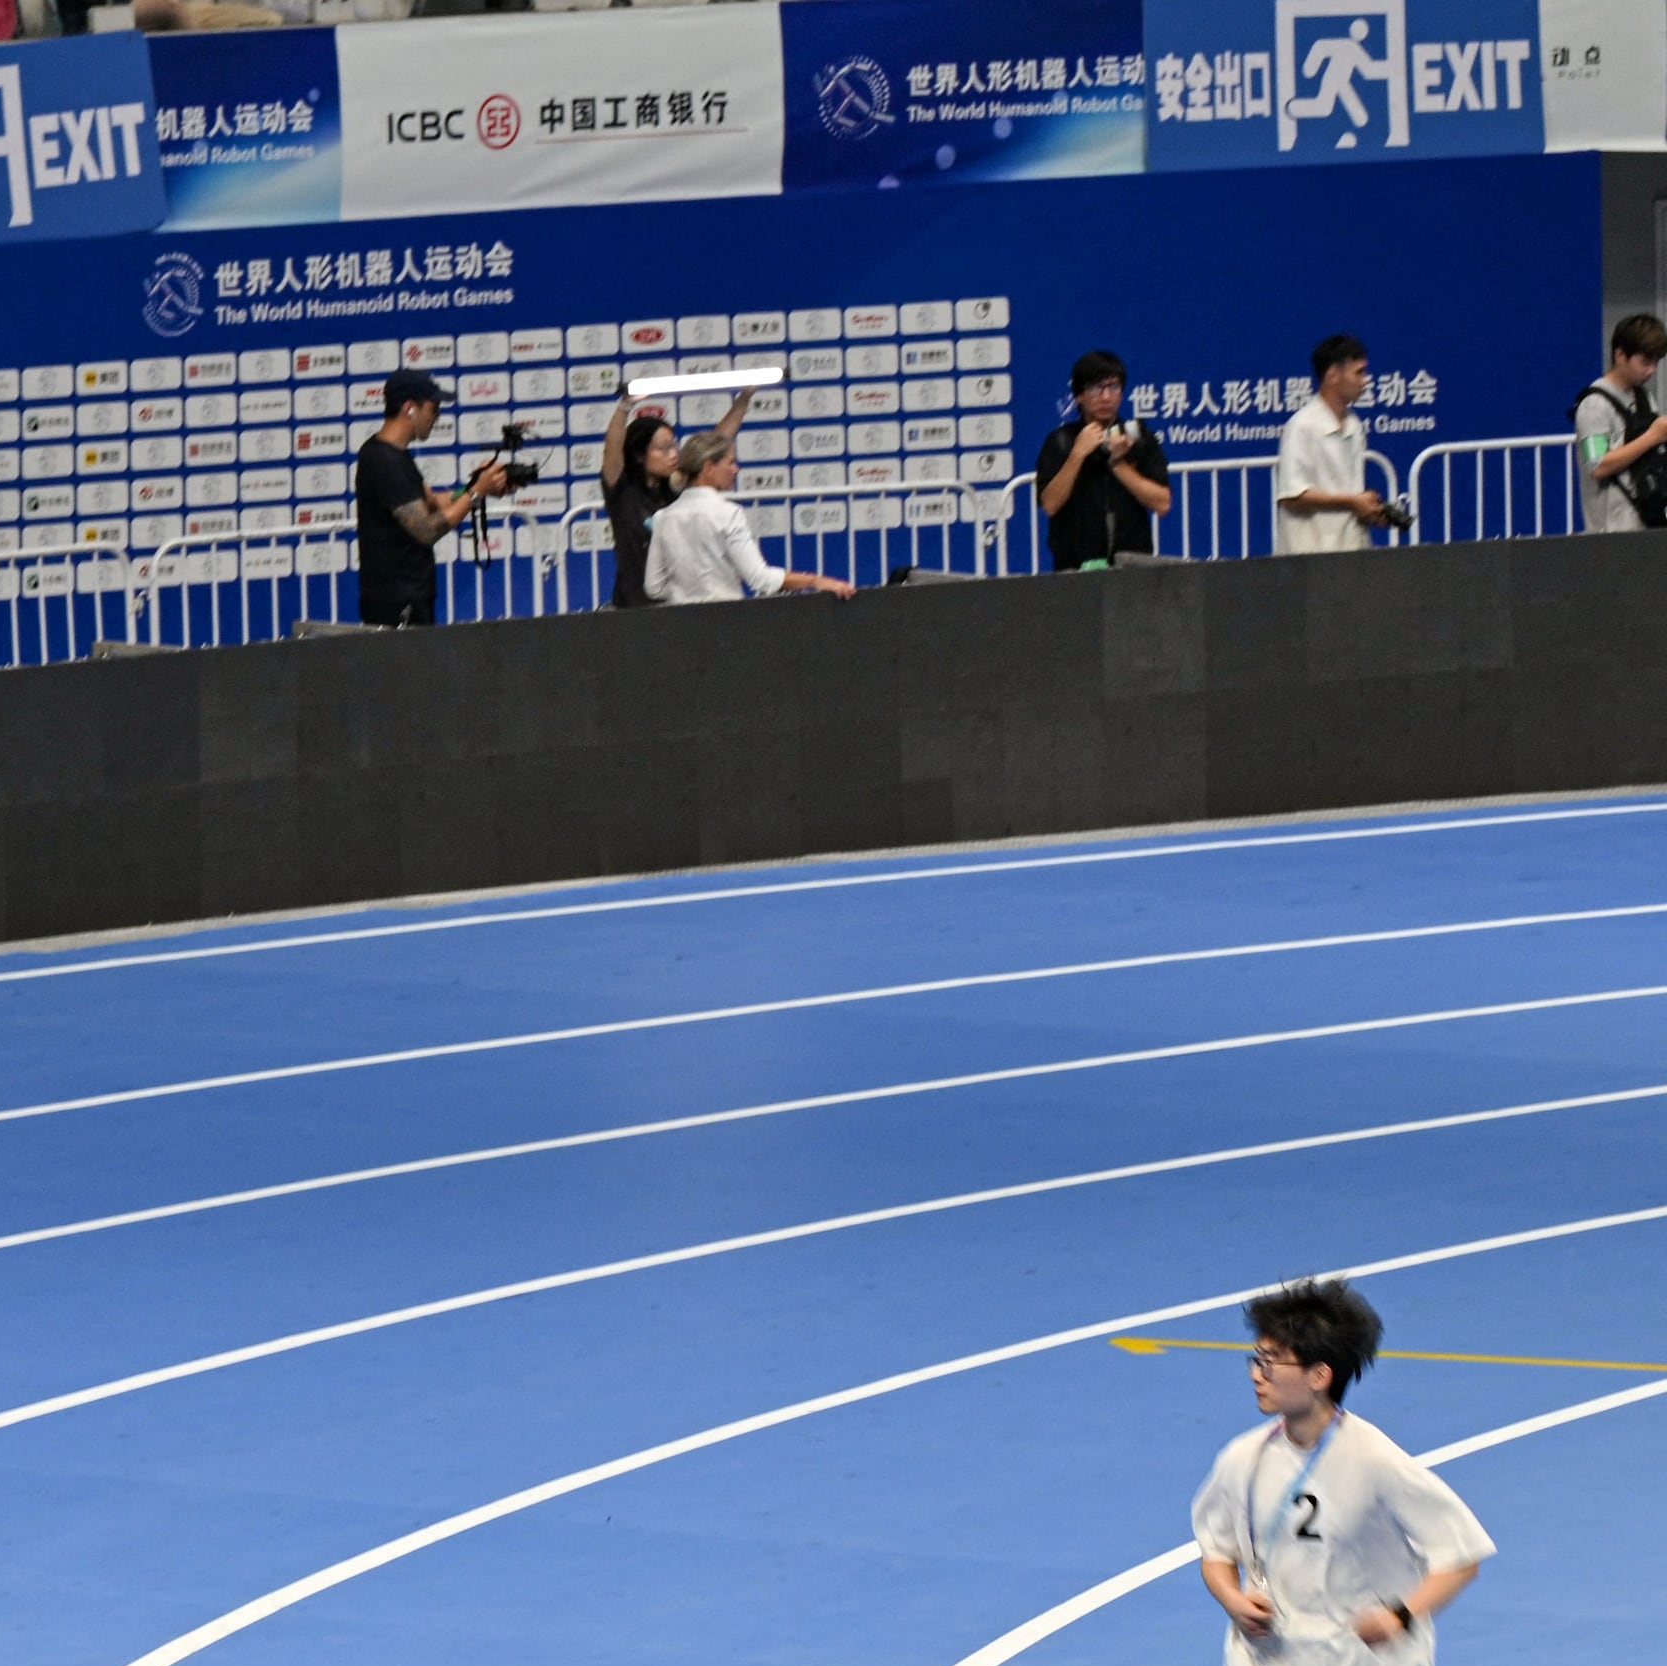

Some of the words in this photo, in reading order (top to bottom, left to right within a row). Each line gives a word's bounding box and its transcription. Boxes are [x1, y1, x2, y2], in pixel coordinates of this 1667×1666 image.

[906, 54, 1145, 97] 世界人形机器人运动
[1156, 50, 1273, 123] 安全出口
[1413, 39, 1530, 111] EXIT
[156, 98, 314, 142] 机器人运动会
[387, 109, 465, 144] ICBC
[539, 90, 728, 135] 中国工商银行
[907, 105, 935, 123] The
[939, 102, 985, 121] World
[988, 95, 1068, 118] Humanoid
[1071, 95, 1118, 114] Robot
[31, 102, 146, 189] EXIT
[160, 146, 208, 168] anoid
[210, 144, 258, 164] Robot
[260, 142, 315, 161] Games
[214, 240, 514, 297] 世界人形机器人运动会
[214, 305, 247, 326] The
[250, 299, 303, 323] World
[306, 293, 394, 319] Humanoid
[397, 290, 449, 311] Robot
[454, 287, 514, 307] Games
[1128, 369, 1438, 419] 世界人形机器运动会
[1168, 422, 1221, 445] World
[1224, 420, 1283, 442] Human
[1374, 414, 1435, 435] Games
[1294, 1493, 1323, 1542] 2
